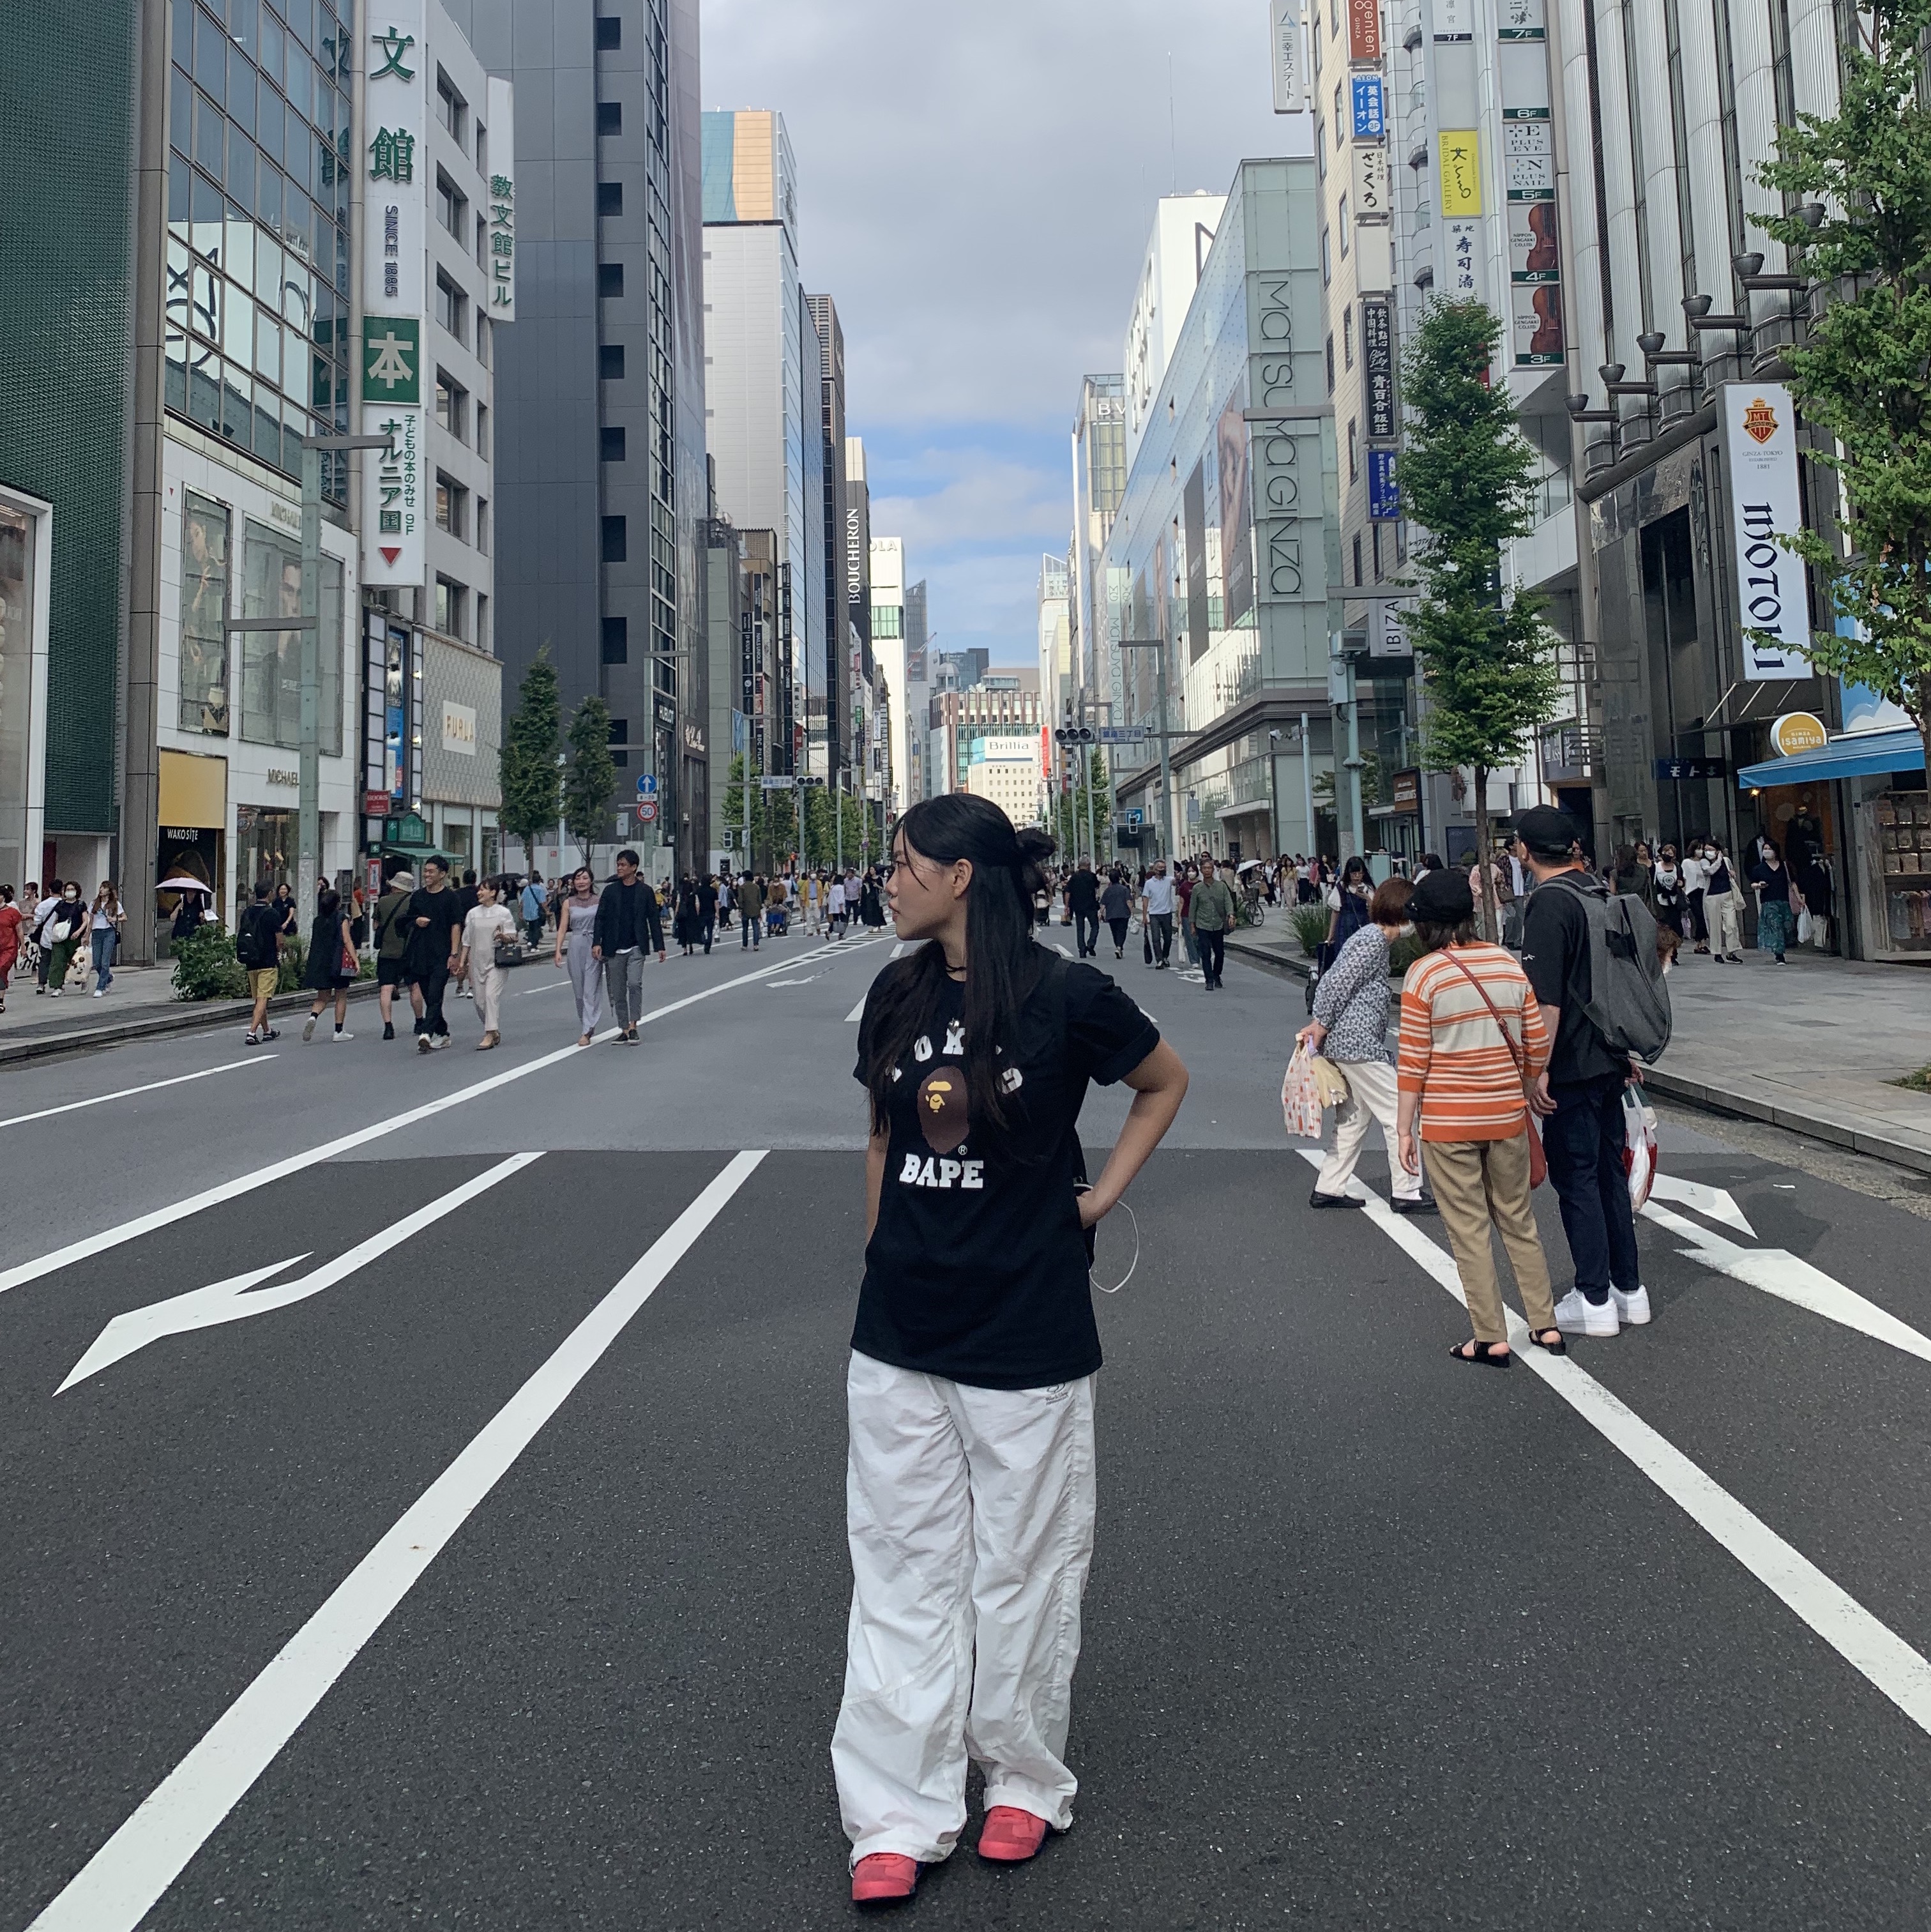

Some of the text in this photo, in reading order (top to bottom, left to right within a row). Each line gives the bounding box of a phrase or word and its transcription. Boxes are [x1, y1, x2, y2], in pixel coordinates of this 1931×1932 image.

[1354, 1, 1376, 53] genten
[1512, 29, 1533, 39] 7F
[1282, 33, 1294, 100] 三幸エステート
[1356, 86, 1367, 132] イーオン
[1367, 86, 1379, 119] 英会話
[1517, 109, 1537, 118] 6F
[1362, 152, 1377, 208] ざくろ
[1441, 135, 1453, 211] BRIDAL GALLERY
[1522, 190, 1542, 199] 5F
[384, 205, 398, 297] SINCE 1885
[490, 174, 515, 305] 教文館ビル
[1526, 271, 1547, 281] 4F
[1367, 308, 1377, 347] 中国料理
[367, 331, 414, 389] 本
[1531, 354, 1551, 363] 3F
[1372, 374, 1389, 434] 青百合飯荘
[379, 418, 403, 533] ナルニア国
[404, 415, 416, 535] 子どもの本のみせ 9F
[847, 508, 861, 605] BOUCHERON
[1384, 600, 1402, 652] IBIZA
[446, 715, 474, 743] FURLA
[989, 741, 1029, 750] Brillia
[267, 768, 299, 786] MICHAEL
[642, 807, 653, 816] 50
[898, 1153, 984, 1189] BAPE
